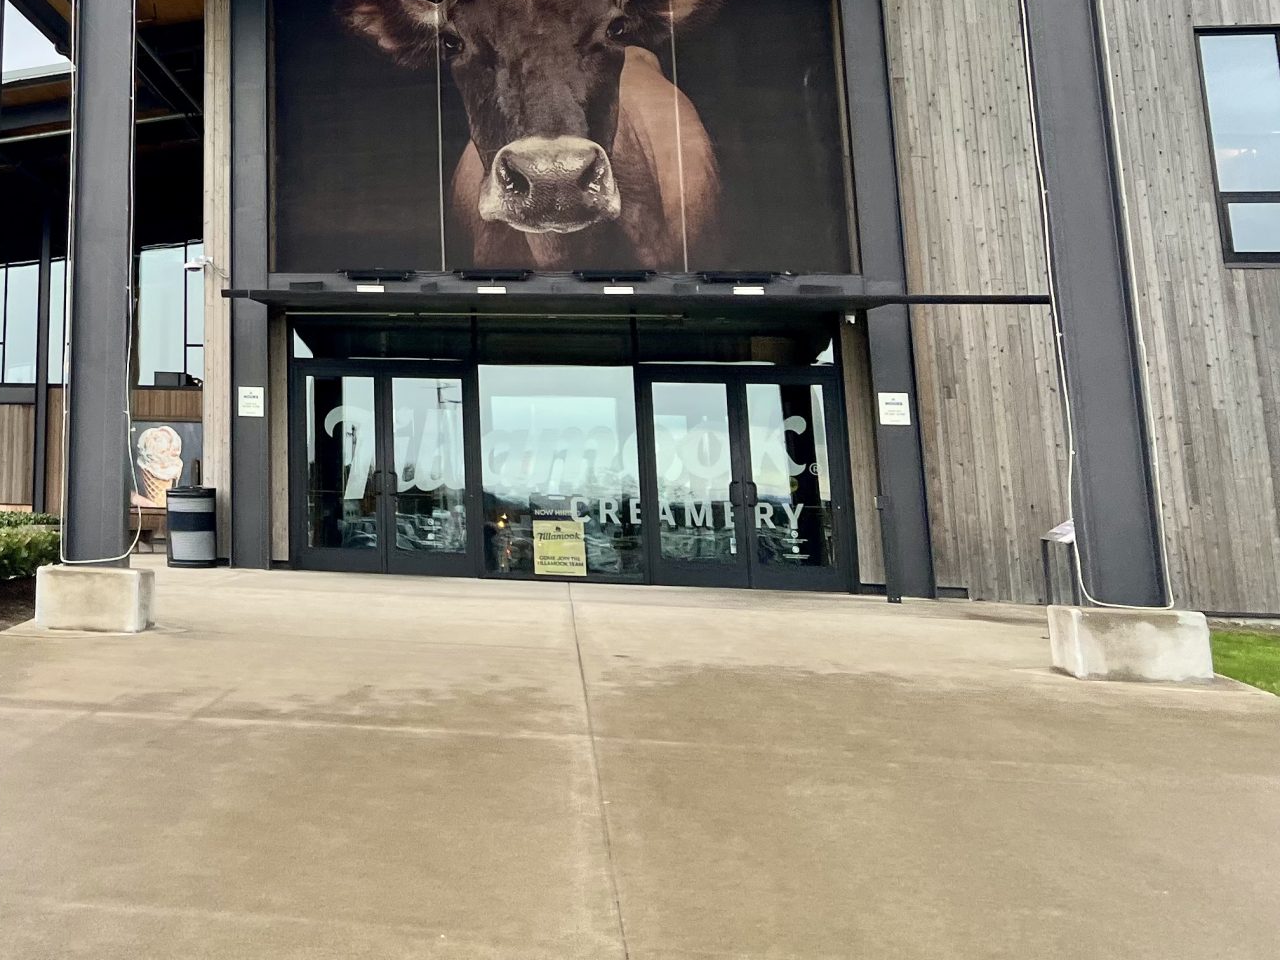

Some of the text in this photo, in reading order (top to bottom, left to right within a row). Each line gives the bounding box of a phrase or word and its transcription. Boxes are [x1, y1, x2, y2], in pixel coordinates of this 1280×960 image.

[324, 405, 807, 500] Tillamook
[571, 497, 804, 529] CREAMERY
[537, 532, 580, 541] Tillamook
